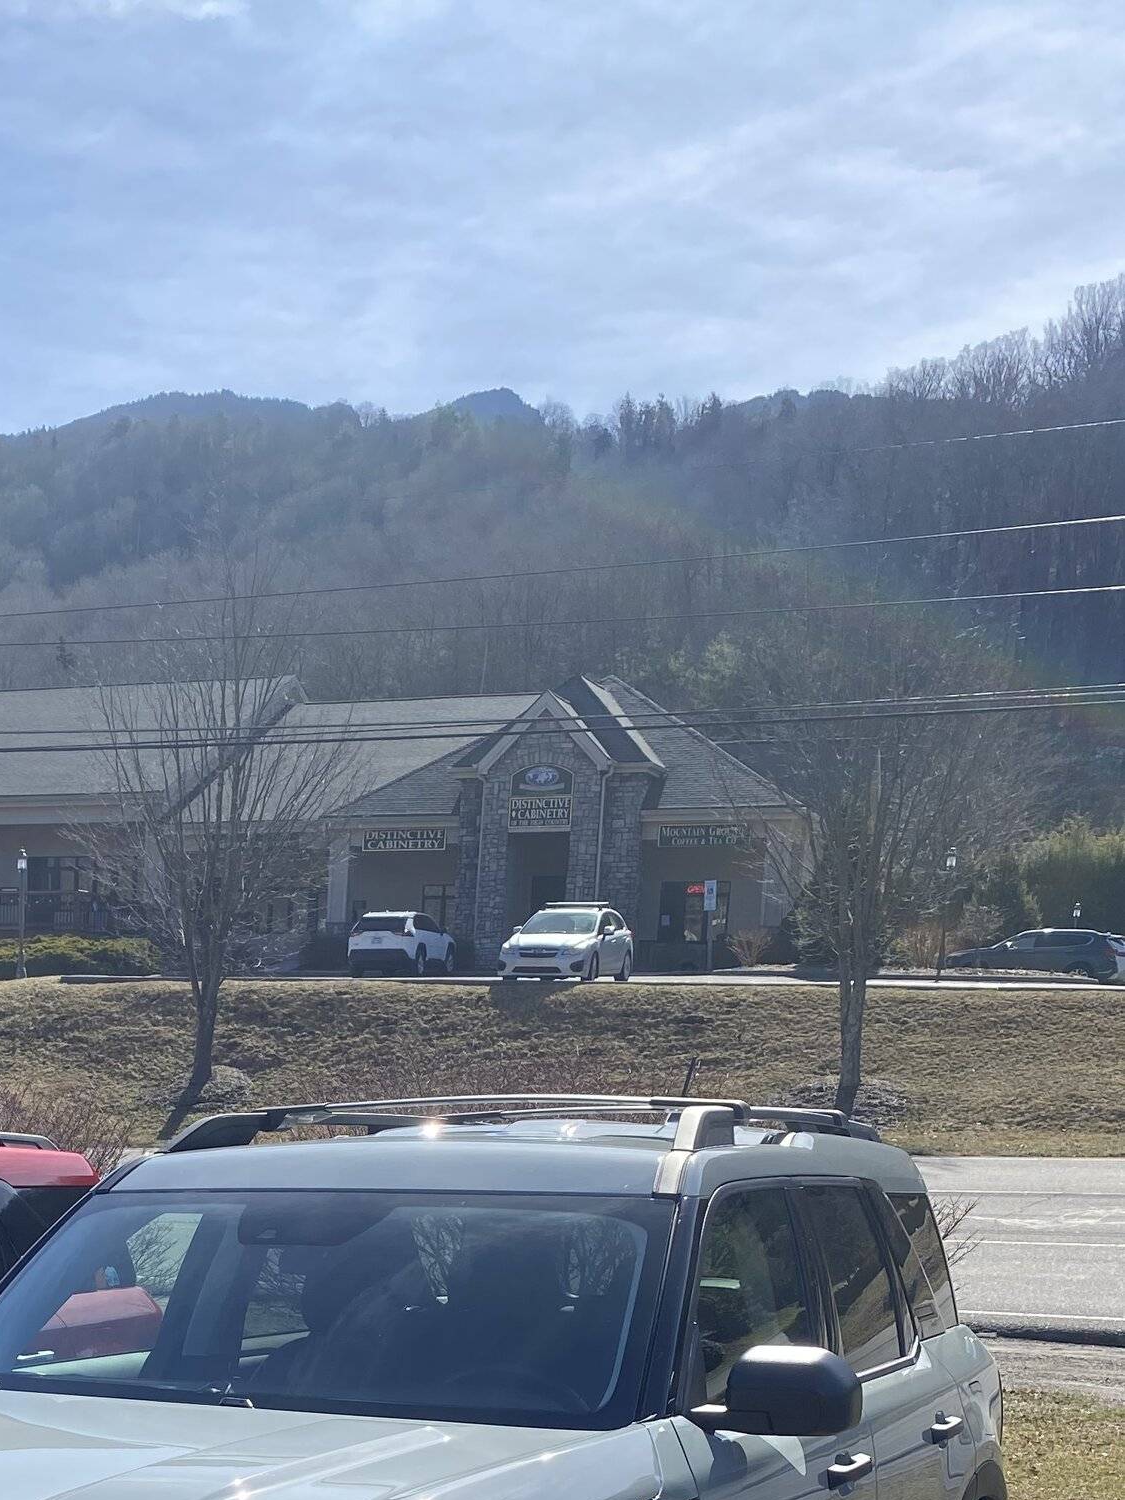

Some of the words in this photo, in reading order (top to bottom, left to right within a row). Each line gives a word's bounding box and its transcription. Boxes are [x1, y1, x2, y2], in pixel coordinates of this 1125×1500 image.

[512, 798, 570, 809] DISTINCTIVE
[518, 809, 569, 819] CABINETRY
[366, 829, 444, 840] DISTINCTIVE
[367, 839, 441, 849] CABINETRY
